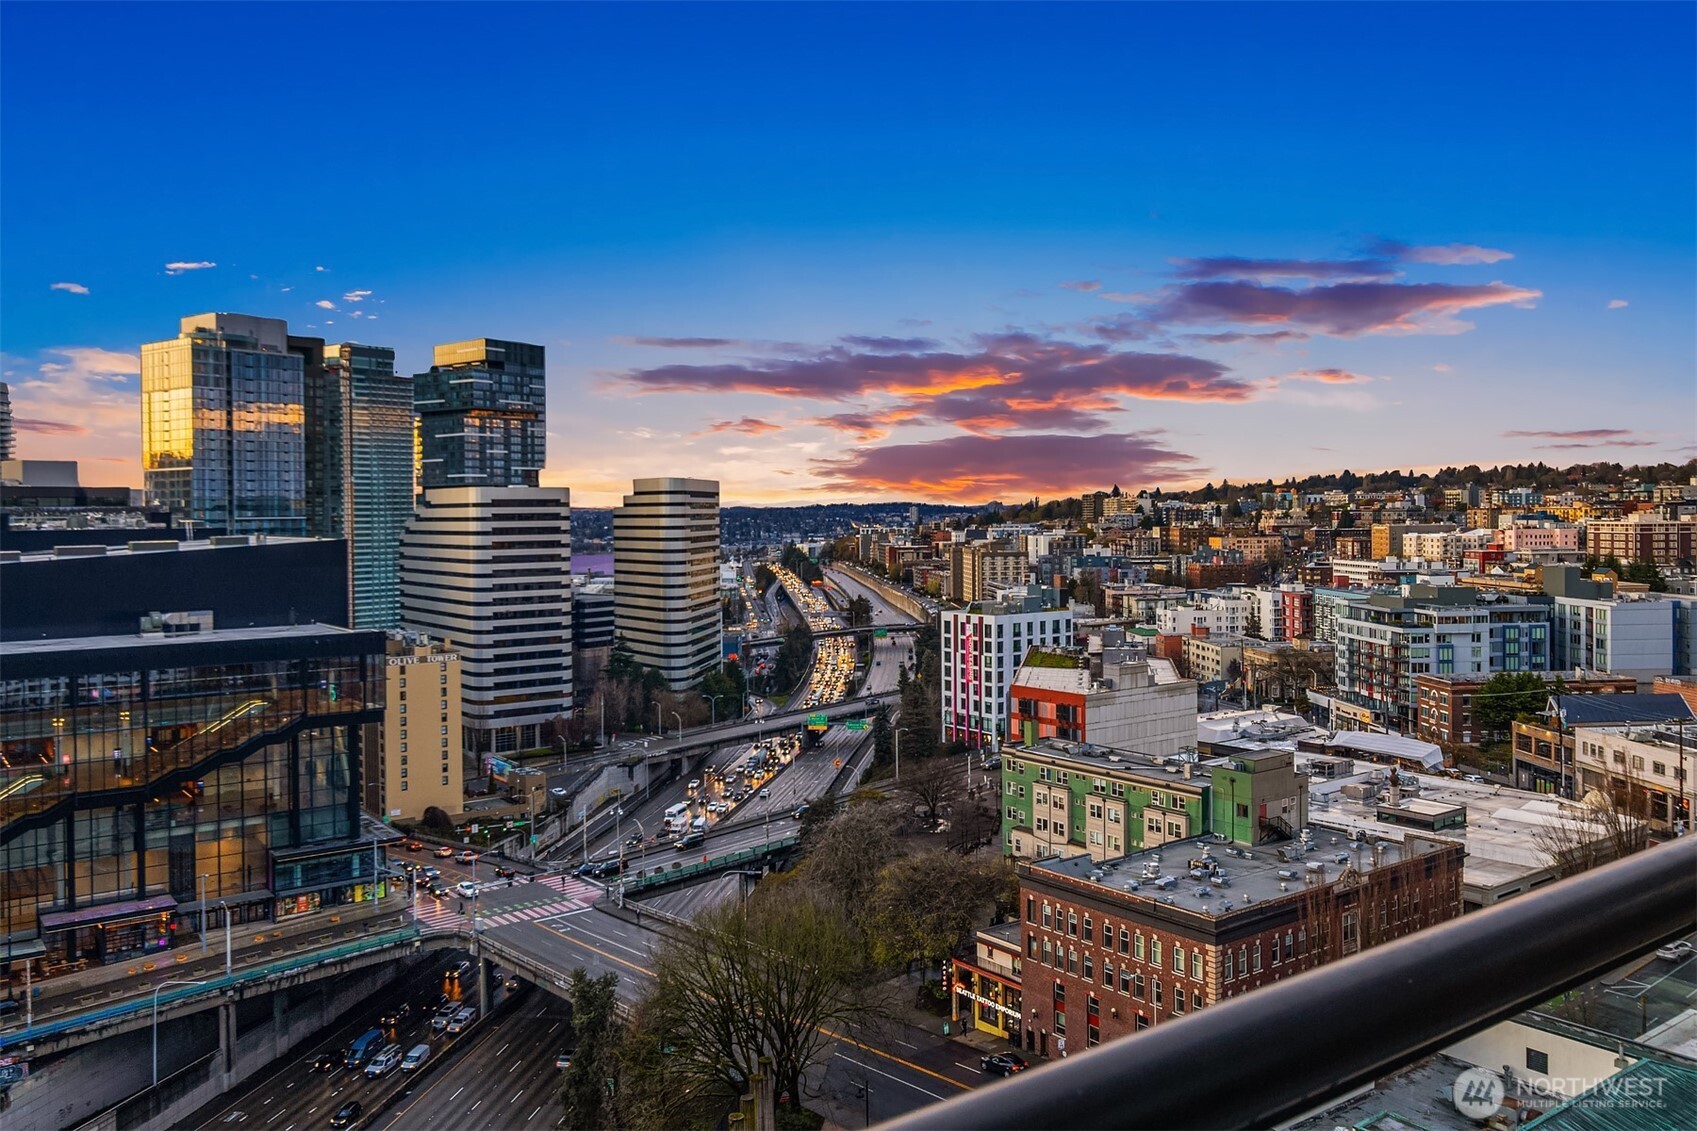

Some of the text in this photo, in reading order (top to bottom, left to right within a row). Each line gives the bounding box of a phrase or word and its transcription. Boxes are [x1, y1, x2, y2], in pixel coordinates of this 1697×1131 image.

[389, 653, 458, 666] OLIVE TOWER
[956, 986, 1022, 1020] SEATTLE TATTOO EMPORIUM
